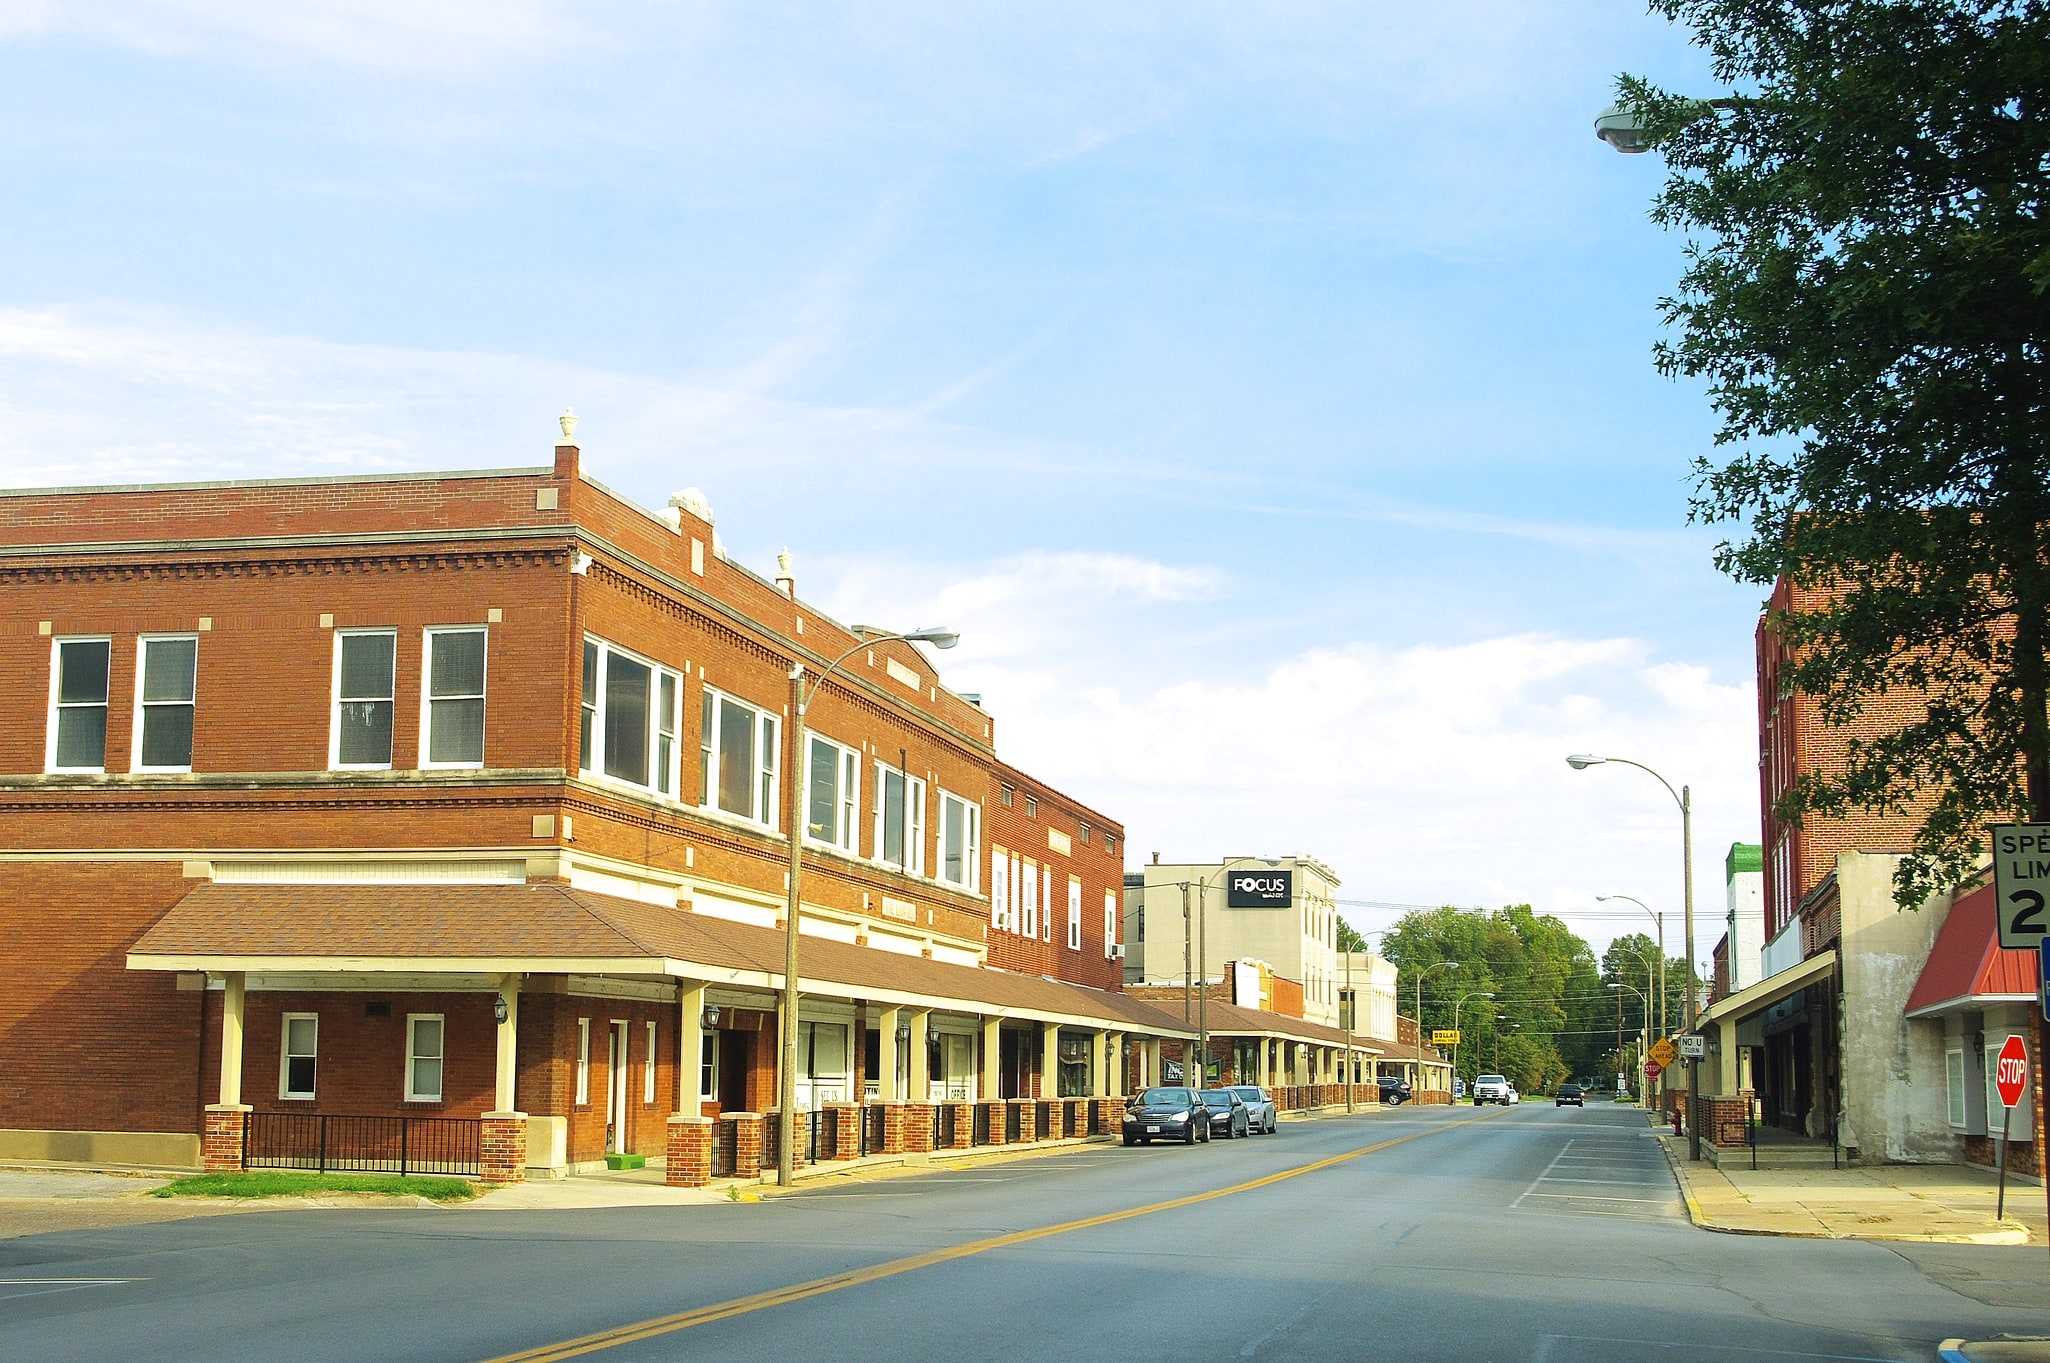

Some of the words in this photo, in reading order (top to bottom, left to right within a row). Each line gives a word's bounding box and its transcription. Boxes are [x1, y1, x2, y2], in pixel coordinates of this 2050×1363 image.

[1234, 877, 1285, 893] FOCUS
[1682, 1038, 1692, 1046] NO
[1696, 1038, 1702, 1046] U
[1999, 1058, 2025, 1084] STOP
